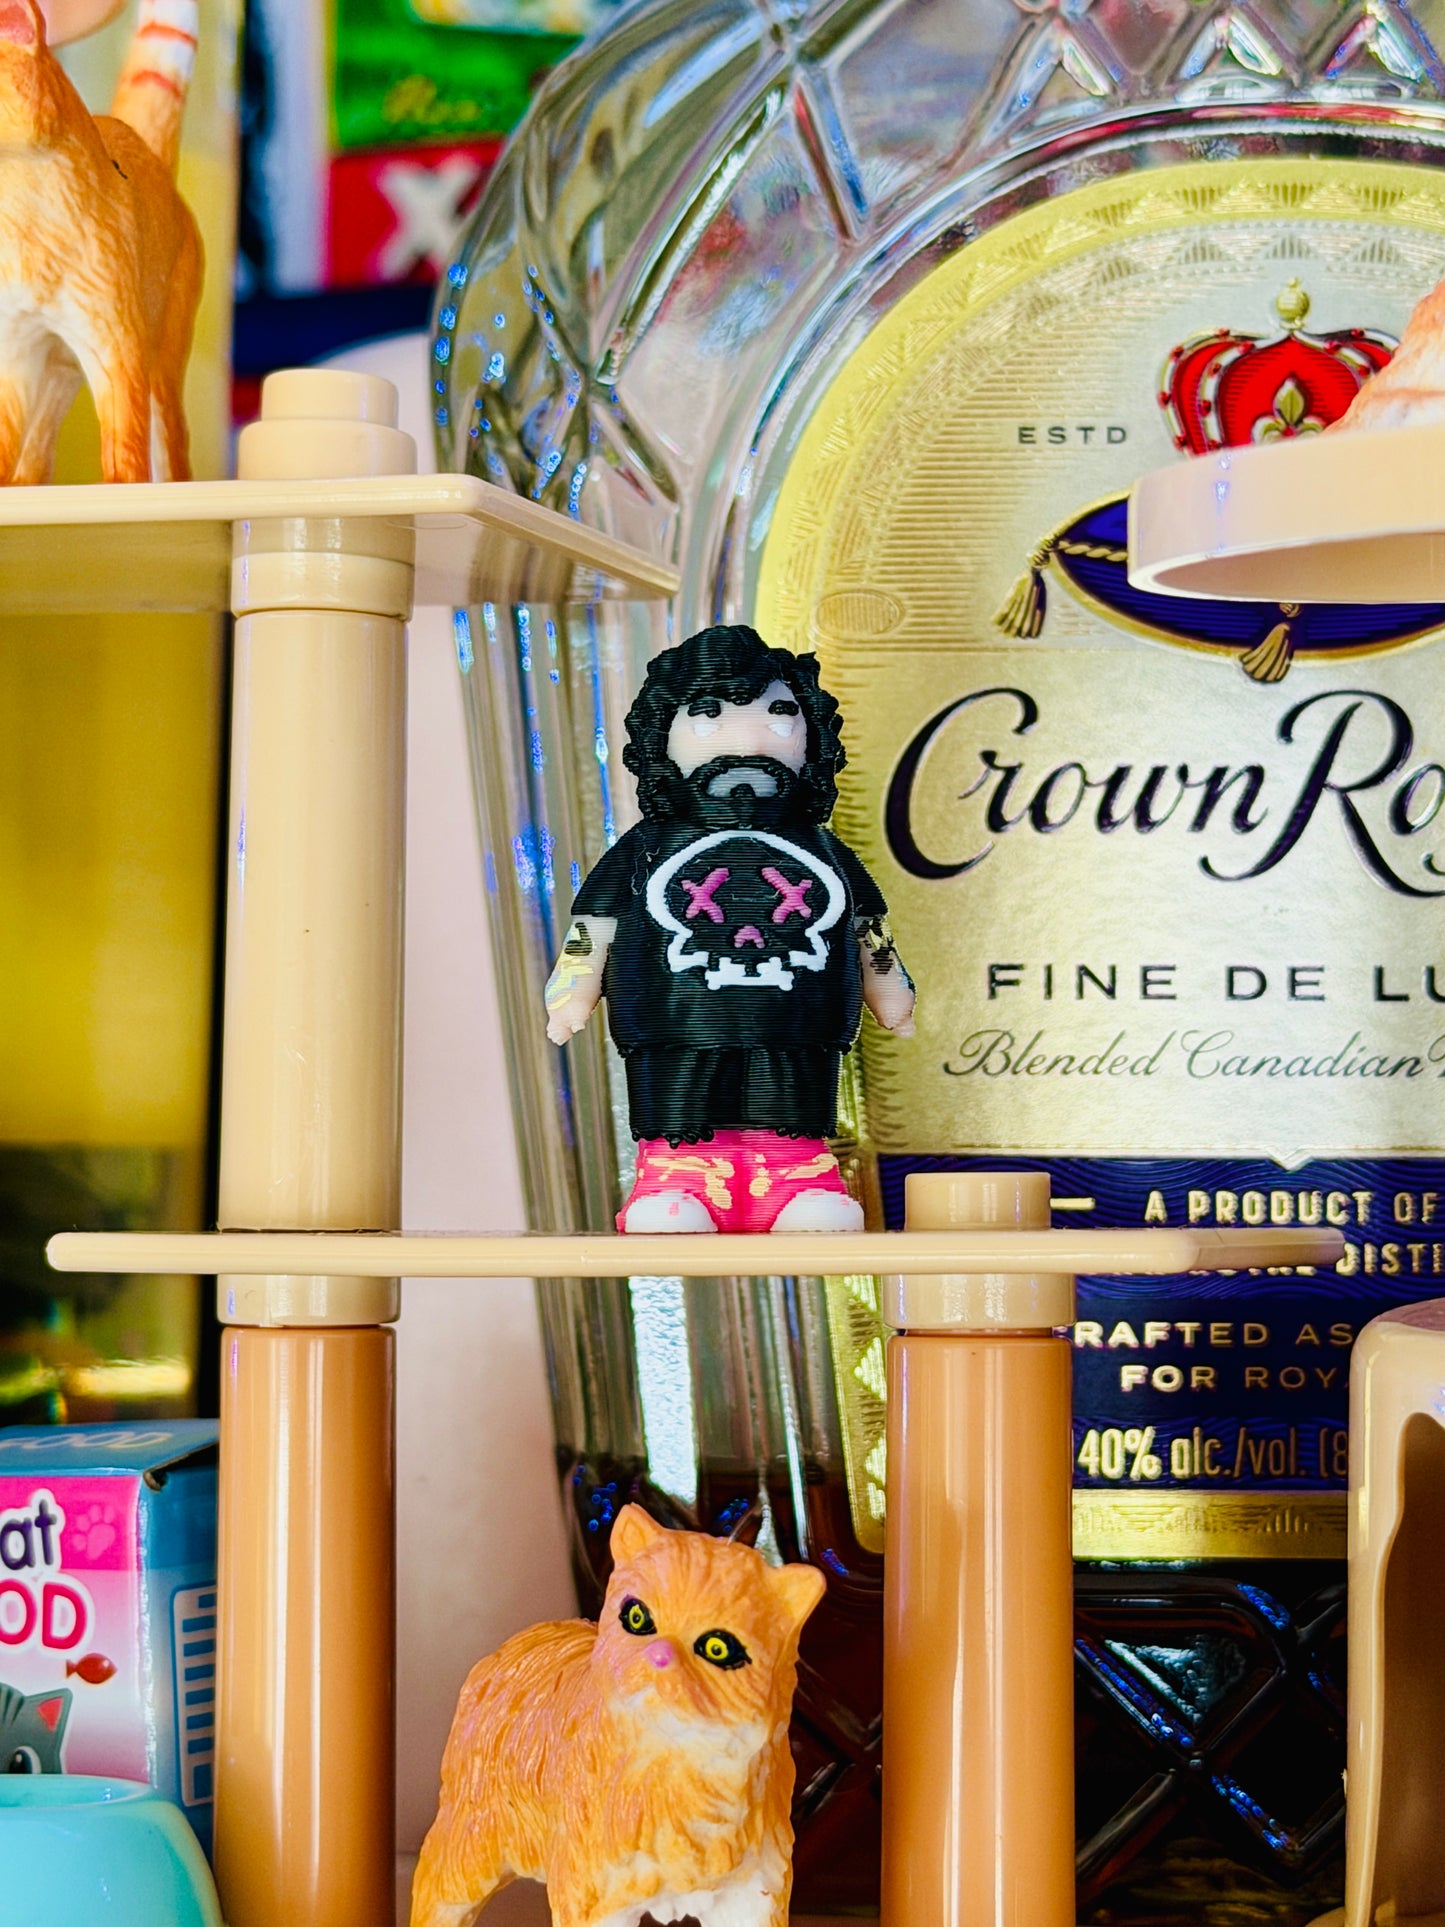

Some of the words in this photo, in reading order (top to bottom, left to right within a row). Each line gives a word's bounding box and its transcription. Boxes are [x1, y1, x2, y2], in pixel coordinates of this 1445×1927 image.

[1018, 426, 1129, 445] ESTD
[884, 687, 1269, 880] Crown
[1199, 688, 1445, 897] Ro
[986, 963, 1178, 1001] FINE
[1225, 964, 1327, 1002] DE
[943, 1029, 1177, 1077] Blended
[1180, 1029, 1425, 1079] Canadian
[1143, 1190, 1169, 1223] A
[1187, 1190, 1375, 1225] PRODUCT
[1393, 1191, 1439, 1225] OF
[1064, 1321, 1269, 1348] RAFTED
[1295, 1322, 1353, 1346] AS
[1120, 1364, 1216, 1392] FOR
[1244, 1365, 1348, 1390] ROY
[1077, 1426, 1163, 1480] 40%
